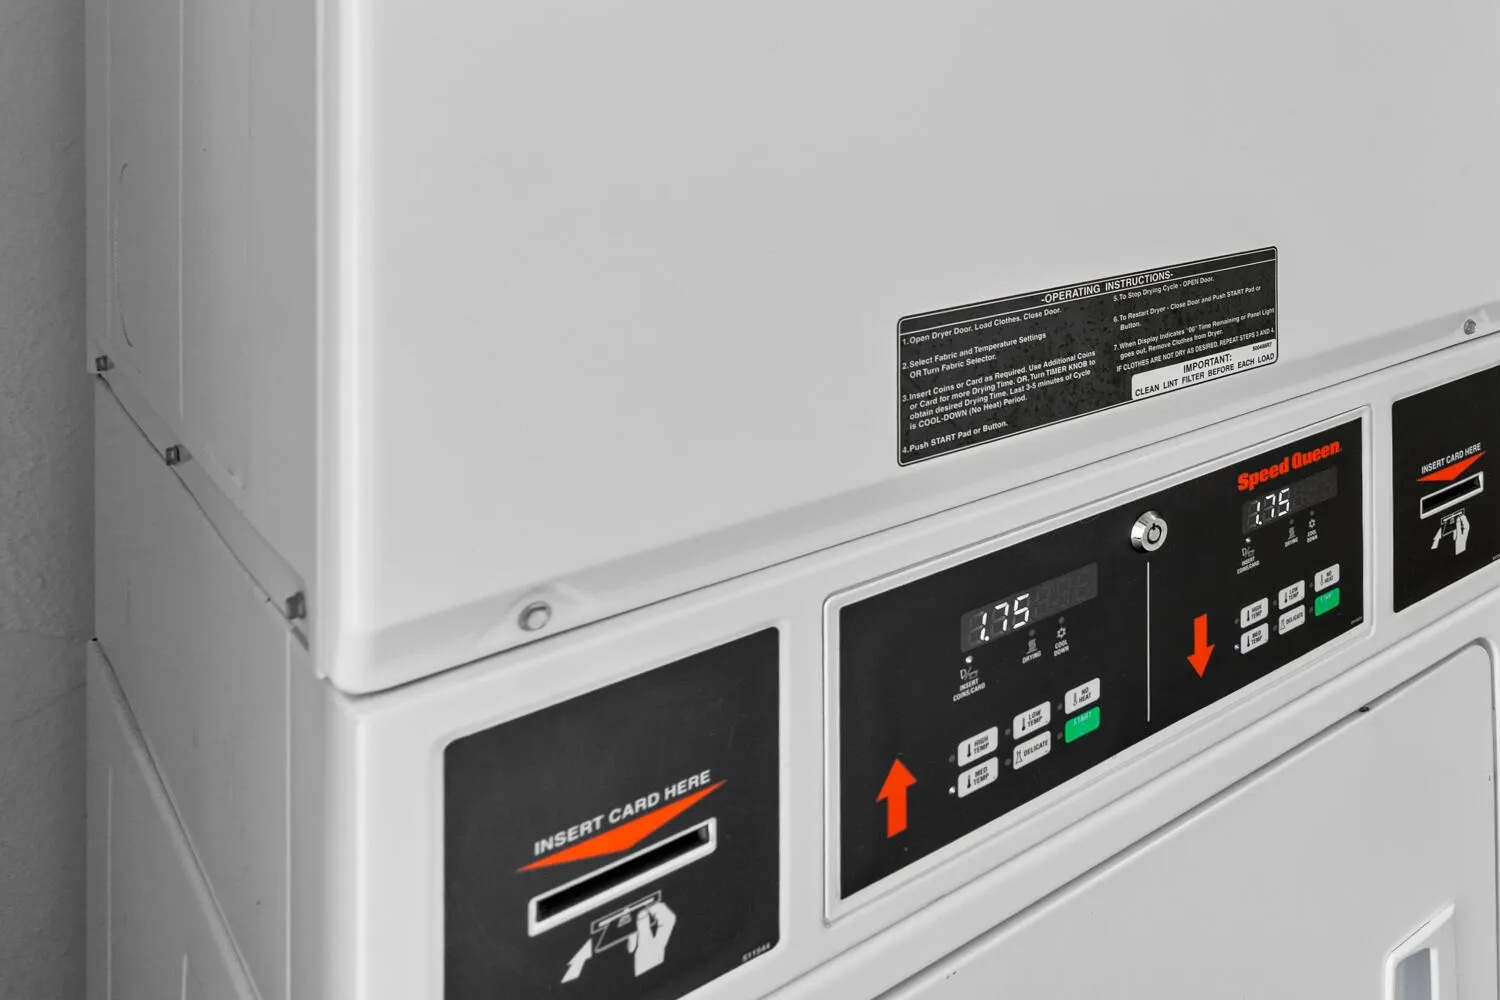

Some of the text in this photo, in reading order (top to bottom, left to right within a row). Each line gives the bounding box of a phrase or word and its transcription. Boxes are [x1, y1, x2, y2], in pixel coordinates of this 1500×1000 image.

[1041, 270, 1173, 304] -OPERATING INSTRUCTIONS-
[1128, 275, 1213, 300] Stop Drying Cycle OPEN Door.
[1128, 289, 1243, 319] Restart Dryer Close Door Push START
[909, 307, 1061, 345] Open Dryer Door. Load Clothes. Close Door.
[1120, 320, 1141, 330] Button.
[1120, 307, 1274, 349] When Display Indicates Time Remaining Panel Light
[910, 332, 1046, 367] Select Fabric and Temperature Settings
[1120, 328, 1223, 360] goes Remove Clothes from Dryer.
[1123, 331, 1254, 370] CLOTHES REPEAT STEPS
[909, 350, 1095, 399] Insert Coins Card Required. Additional Coins
[923, 353, 996, 375] Turn Fabric Selector.
[1135, 352, 1274, 396] CLEAN LINT FILTER BEFORE EACH LOAD
[1183, 352, 1231, 373] IMPORTANT:
[909, 369, 1090, 420] obtain desired Drying Time. Last 3-5 minutes Cycle
[919, 361, 1087, 407] Card more Drying Time. Turn TIMER KNOB
[918, 394, 1026, 427] COOL-DOWN (No Heat) Period.
[910, 419, 1007, 452] Push START Pad Button.
[1238, 441, 1340, 491] Speed Queen
[1421, 442, 1481, 474] INSERT CARD HERE
[1256, 488, 1289, 525] 1.75
[980, 594, 1029, 641] 1.75
[1022, 651, 1041, 664] DRYING
[1054, 646, 1069, 656] DOWN
[1055, 640, 1068, 649] COOL
[953, 683, 985, 701] COINS/CARD
[960, 678, 979, 691] INSERT
[1079, 693, 1092, 703] HEAT
[1028, 716, 1042, 727] TEMP
[1029, 710, 1041, 720] LOW
[1073, 712, 1092, 725] START
[974, 736, 988, 746] HIGH
[974, 742, 989, 754] TEMP
[1024, 740, 1048, 756] DELICATE
[974, 773, 989, 785] TEMP
[975, 766, 988, 777] MED
[534, 770, 711, 856] INSERT CARD HERE
